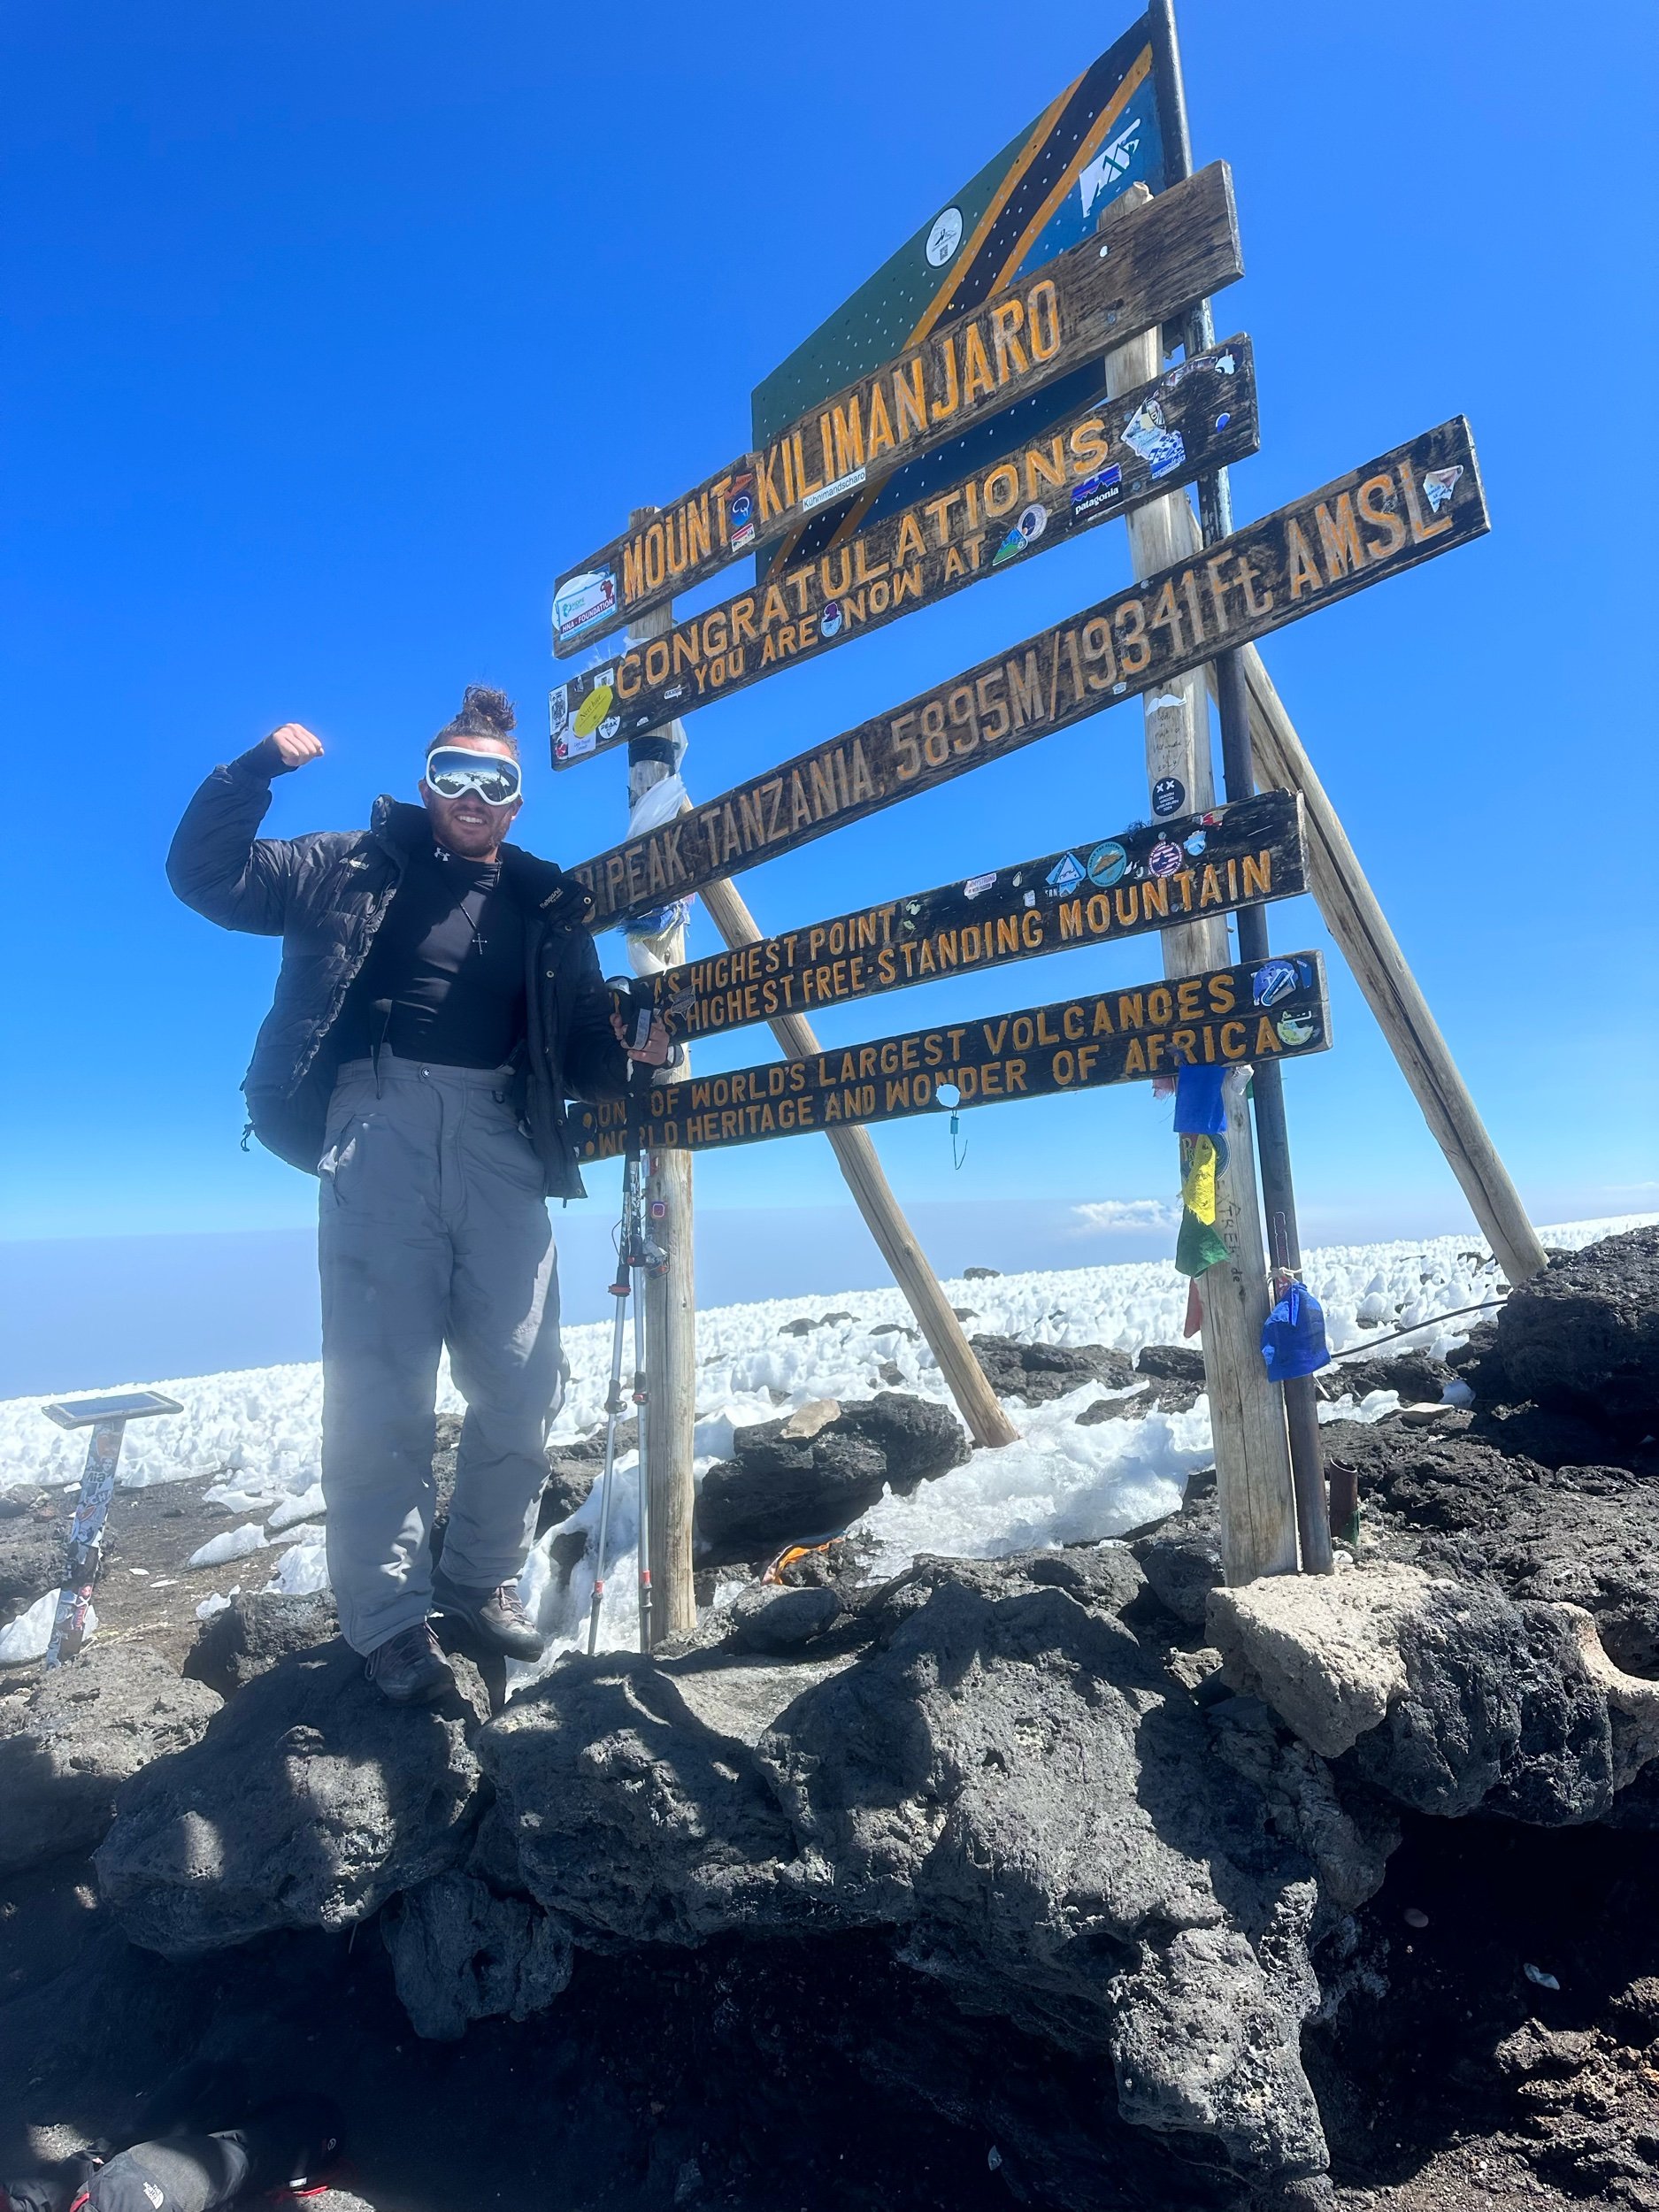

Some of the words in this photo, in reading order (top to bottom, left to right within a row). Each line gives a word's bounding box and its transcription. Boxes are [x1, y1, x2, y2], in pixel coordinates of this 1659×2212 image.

[624, 475, 733, 605] MOUNT
[754, 280, 1061, 523] KILIMANJARO
[1075, 487, 1119, 515] patagonia
[617, 418, 1109, 699] CONGRATULATIONS
[1288, 458, 1452, 600] AMSL
[578, 597, 613, 624] FOUNDATION
[695, 647, 745, 694] YOU
[760, 615, 818, 666] ARE
[841, 563, 923, 622] NOW
[944, 534, 987, 582] AT
[687, 975, 795, 1033] HIGHEST
[1059, 849, 1272, 941] MOUNTAIN
[691, 934, 797, 994] HIGHEST
[810, 906, 896, 961] POINT
[650, 1087, 680, 1118] OF
[692, 1063, 805, 1110] WORLD'S
[818, 1028, 966, 1087] LARGEST
[983, 974, 1236, 1055] VOLCANOES
[687, 1087, 815, 1144] HERITAGE
[824, 1084, 876, 1122] AND
[1053, 1043, 1100, 1086] OF
[1125, 1016, 1282, 1074] AFRICA
